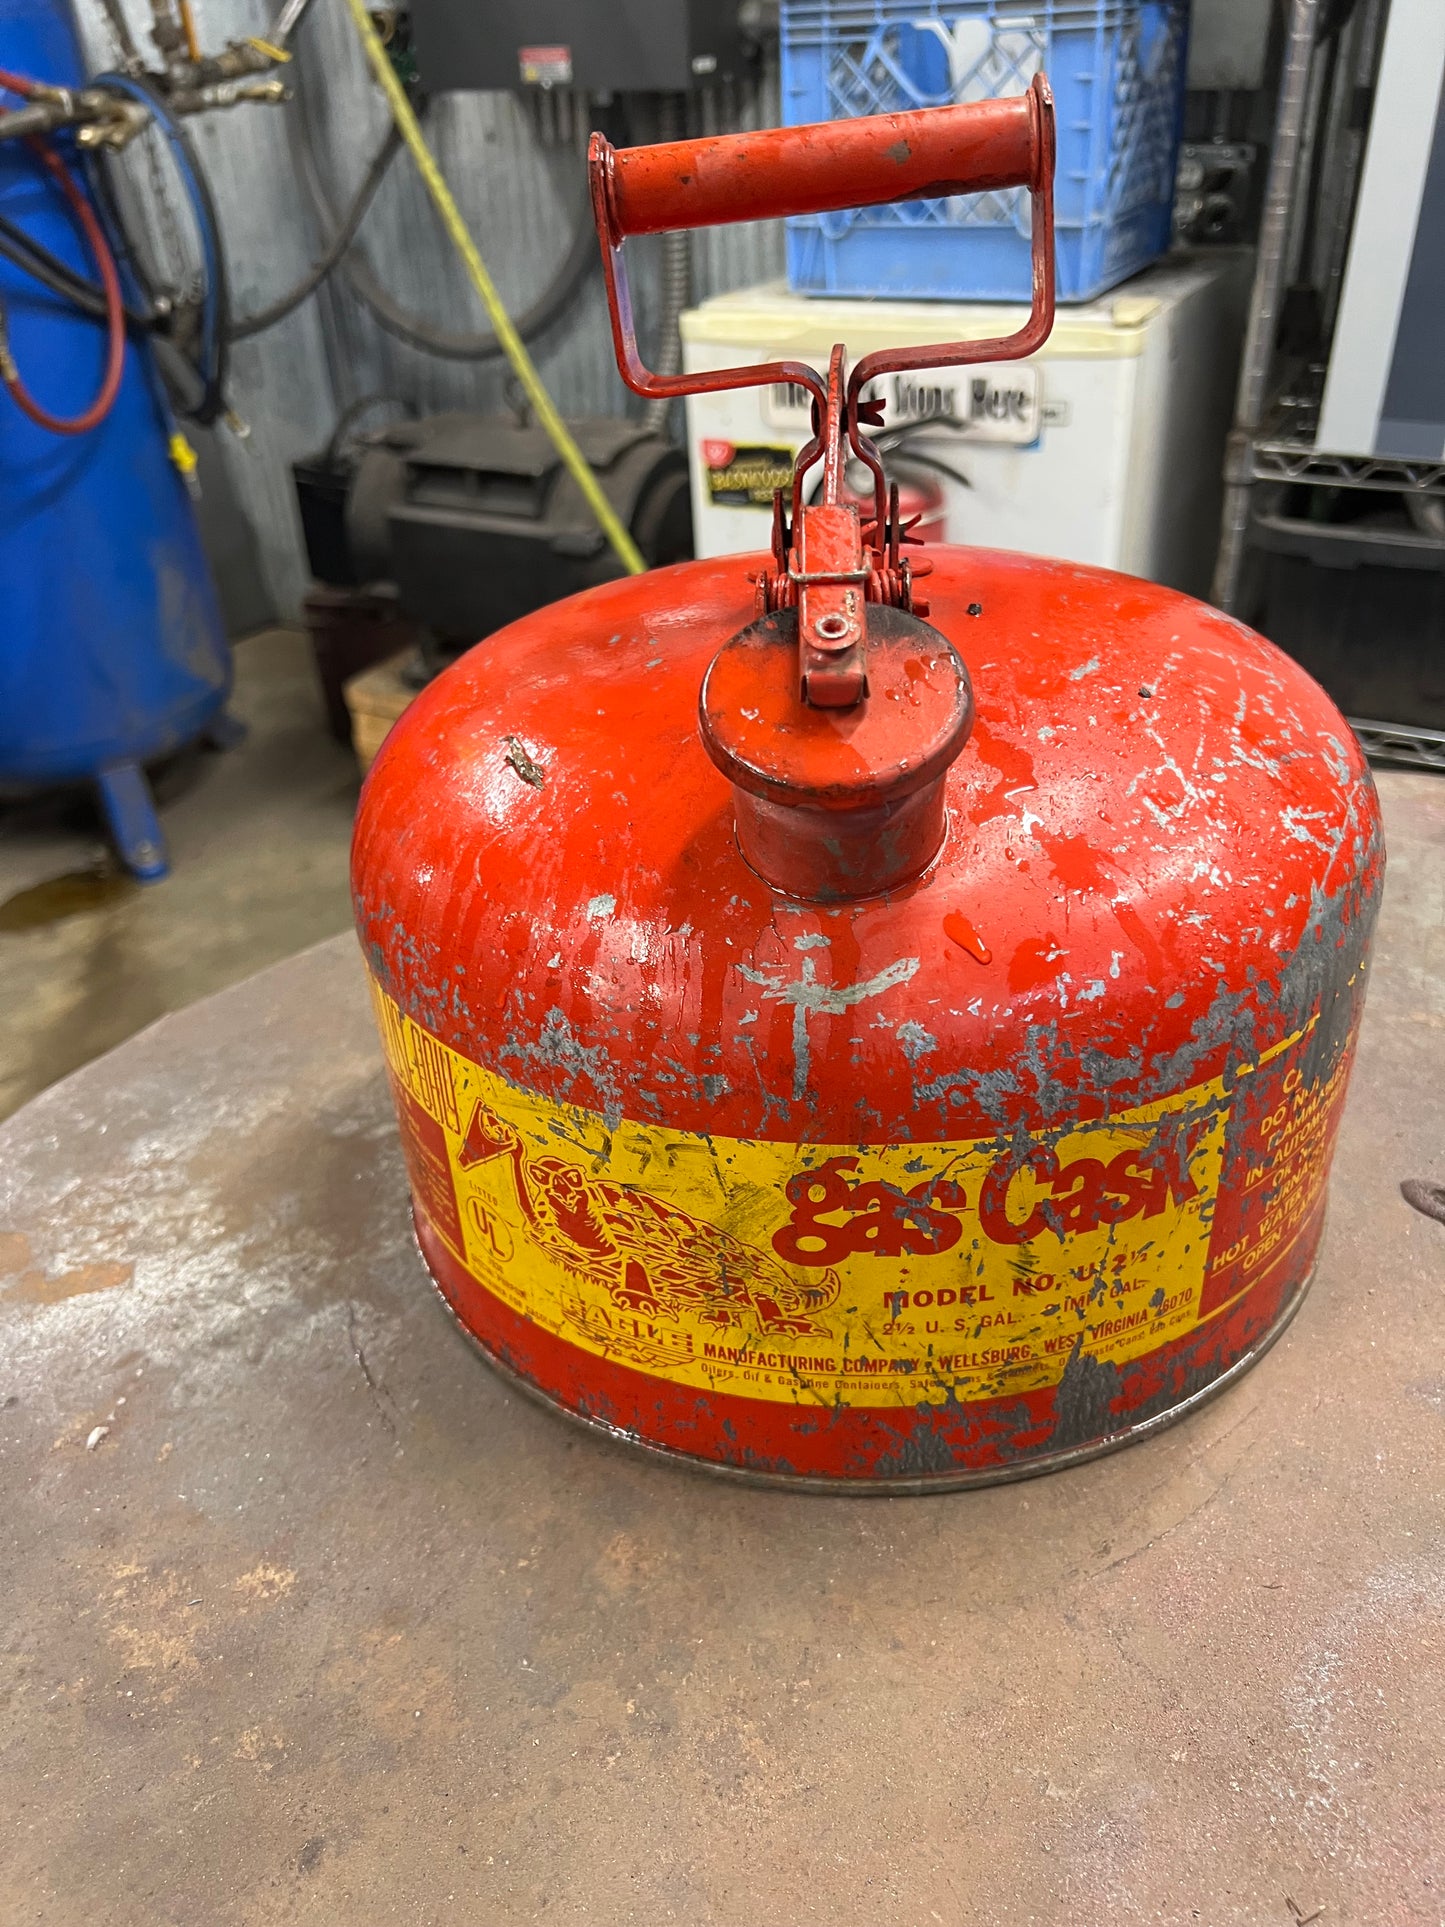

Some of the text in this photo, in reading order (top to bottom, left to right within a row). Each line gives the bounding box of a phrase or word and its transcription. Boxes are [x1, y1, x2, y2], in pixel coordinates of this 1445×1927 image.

[1261, 1106, 1286, 1136] DO
[1246, 1161, 1264, 1186] IN
[1213, 1234, 1249, 1271] HOT
[1243, 1226, 1282, 1269] OPEN
[884, 1284, 995, 1310] MODEL
[560, 1289, 694, 1353] EAGLE
[703, 1342, 837, 1373] MANUFACTURING
[842, 1357, 920, 1374] COMPAY
[1089, 1309, 1149, 1341] VIRGINIA
[1154, 1287, 1192, 1317] 6070
[764, 1373, 773, 1384] &
